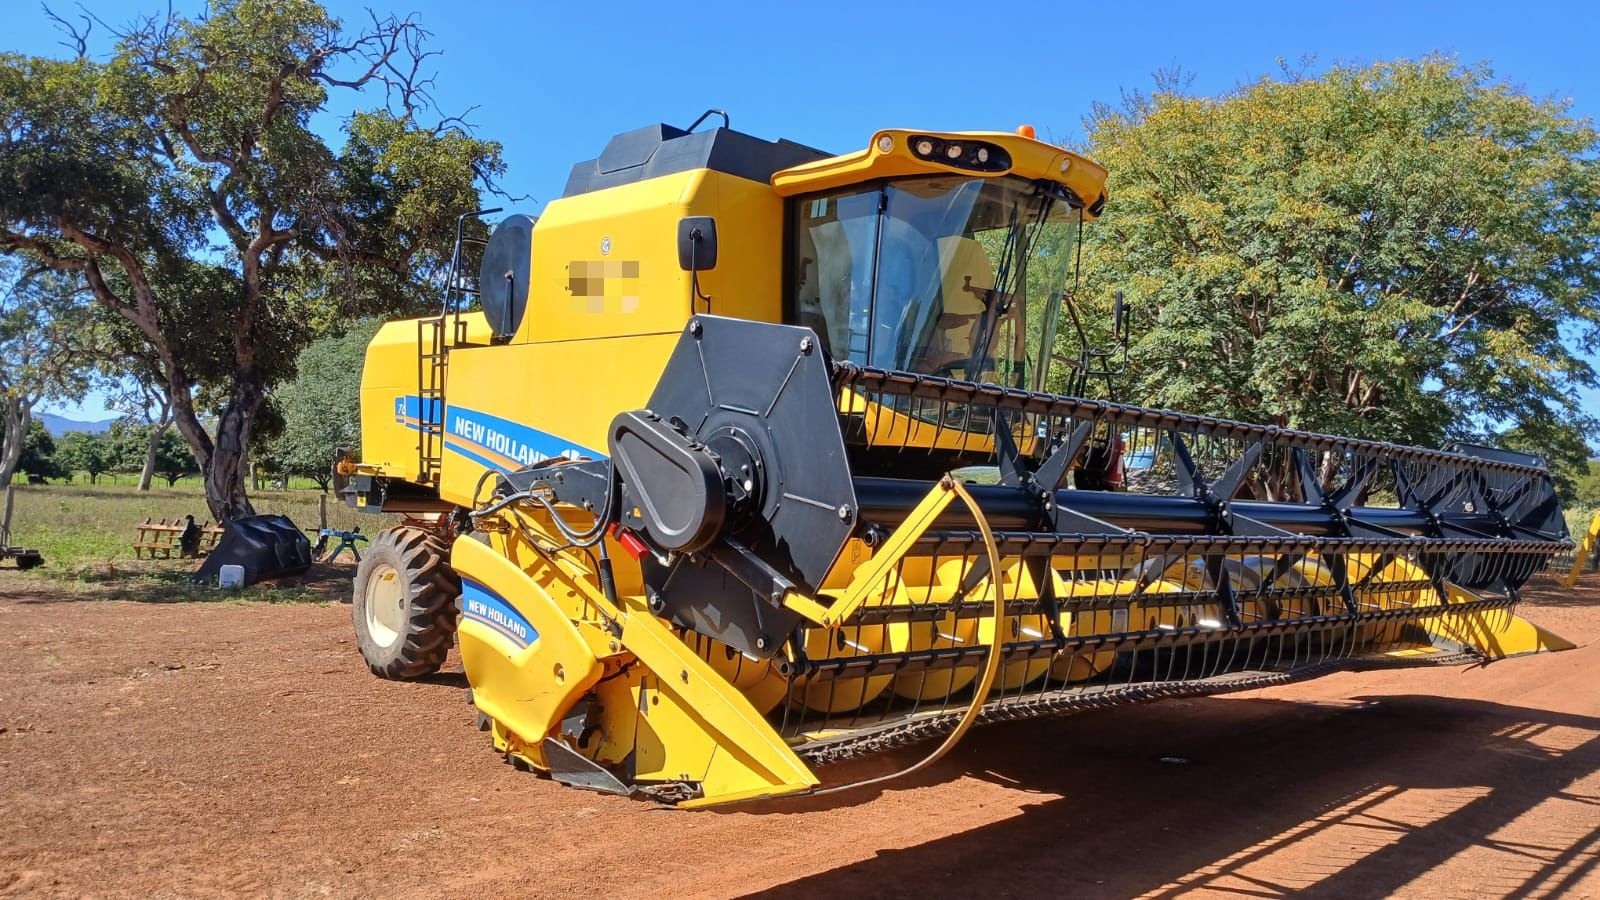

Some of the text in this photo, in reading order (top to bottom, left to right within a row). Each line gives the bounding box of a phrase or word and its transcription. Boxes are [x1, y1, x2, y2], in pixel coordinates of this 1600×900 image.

[455, 416, 484, 444] NEW
[468, 600, 527, 639] NEW HOLLAND
